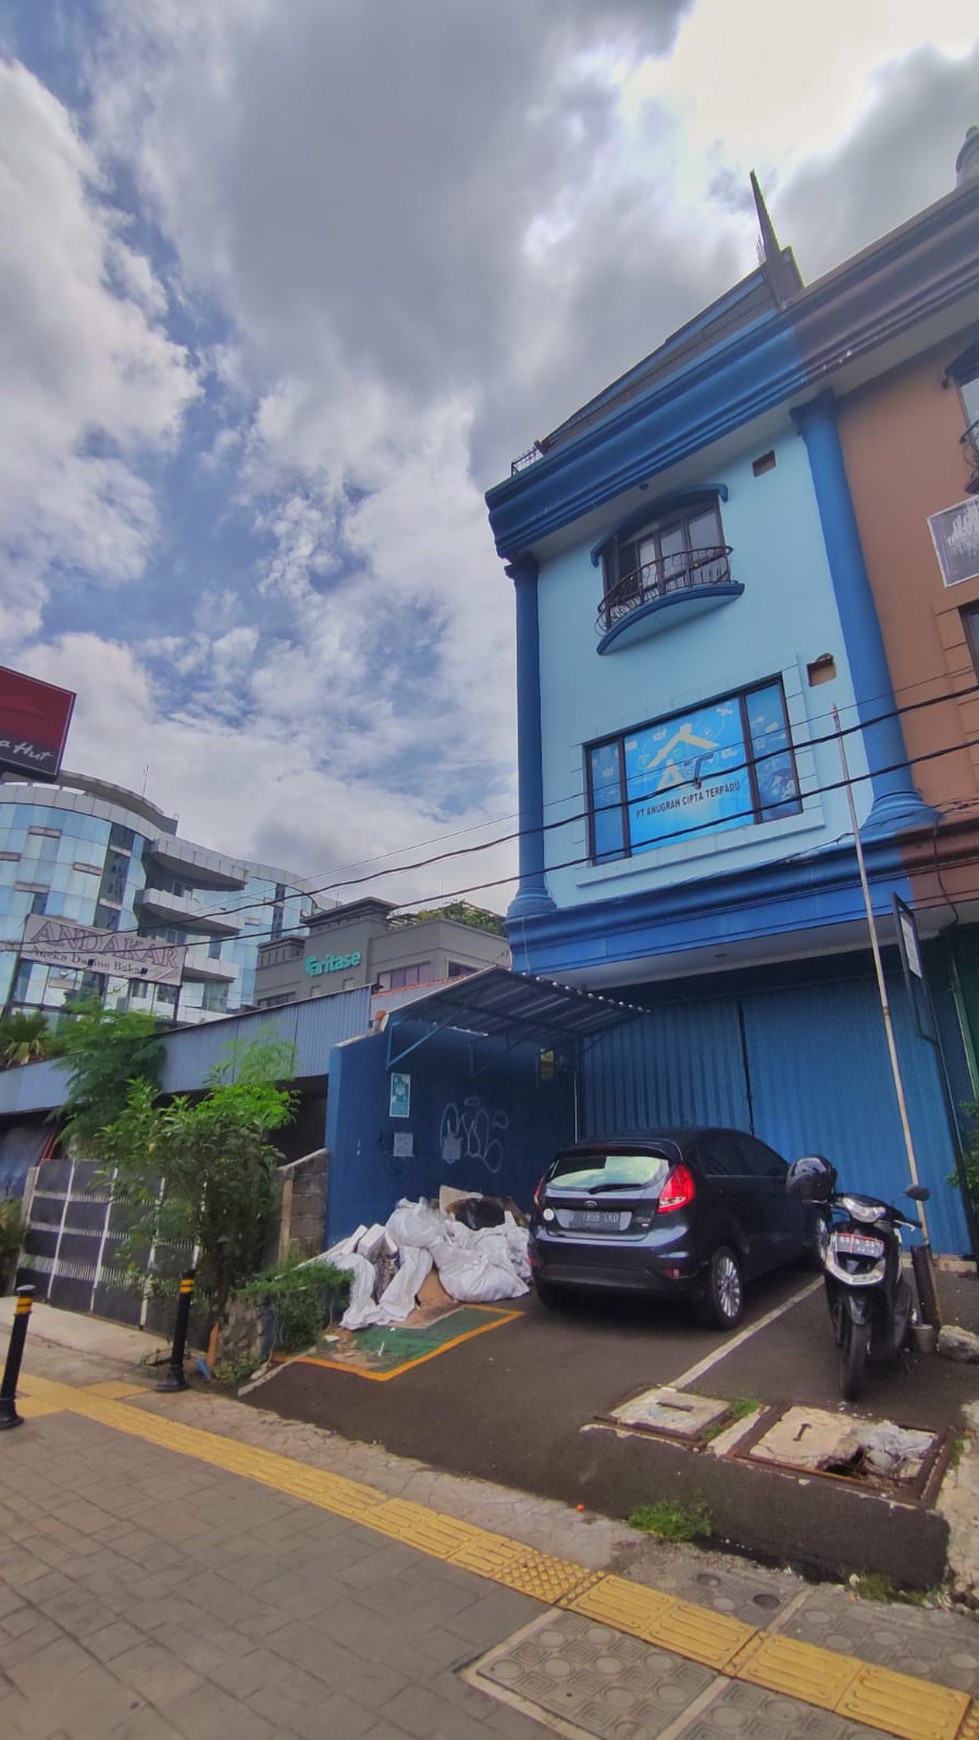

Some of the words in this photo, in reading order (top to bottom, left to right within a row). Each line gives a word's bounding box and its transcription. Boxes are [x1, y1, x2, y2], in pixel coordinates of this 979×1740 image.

[12, 742, 54, 761] Hut
[636, 808, 645, 818] PT
[646, 799, 681, 815] ANUGRAH
[682, 791, 704, 806] CIPTA
[705, 780, 741, 799] TERPADU
[31, 920, 179, 969] ANDAKAR
